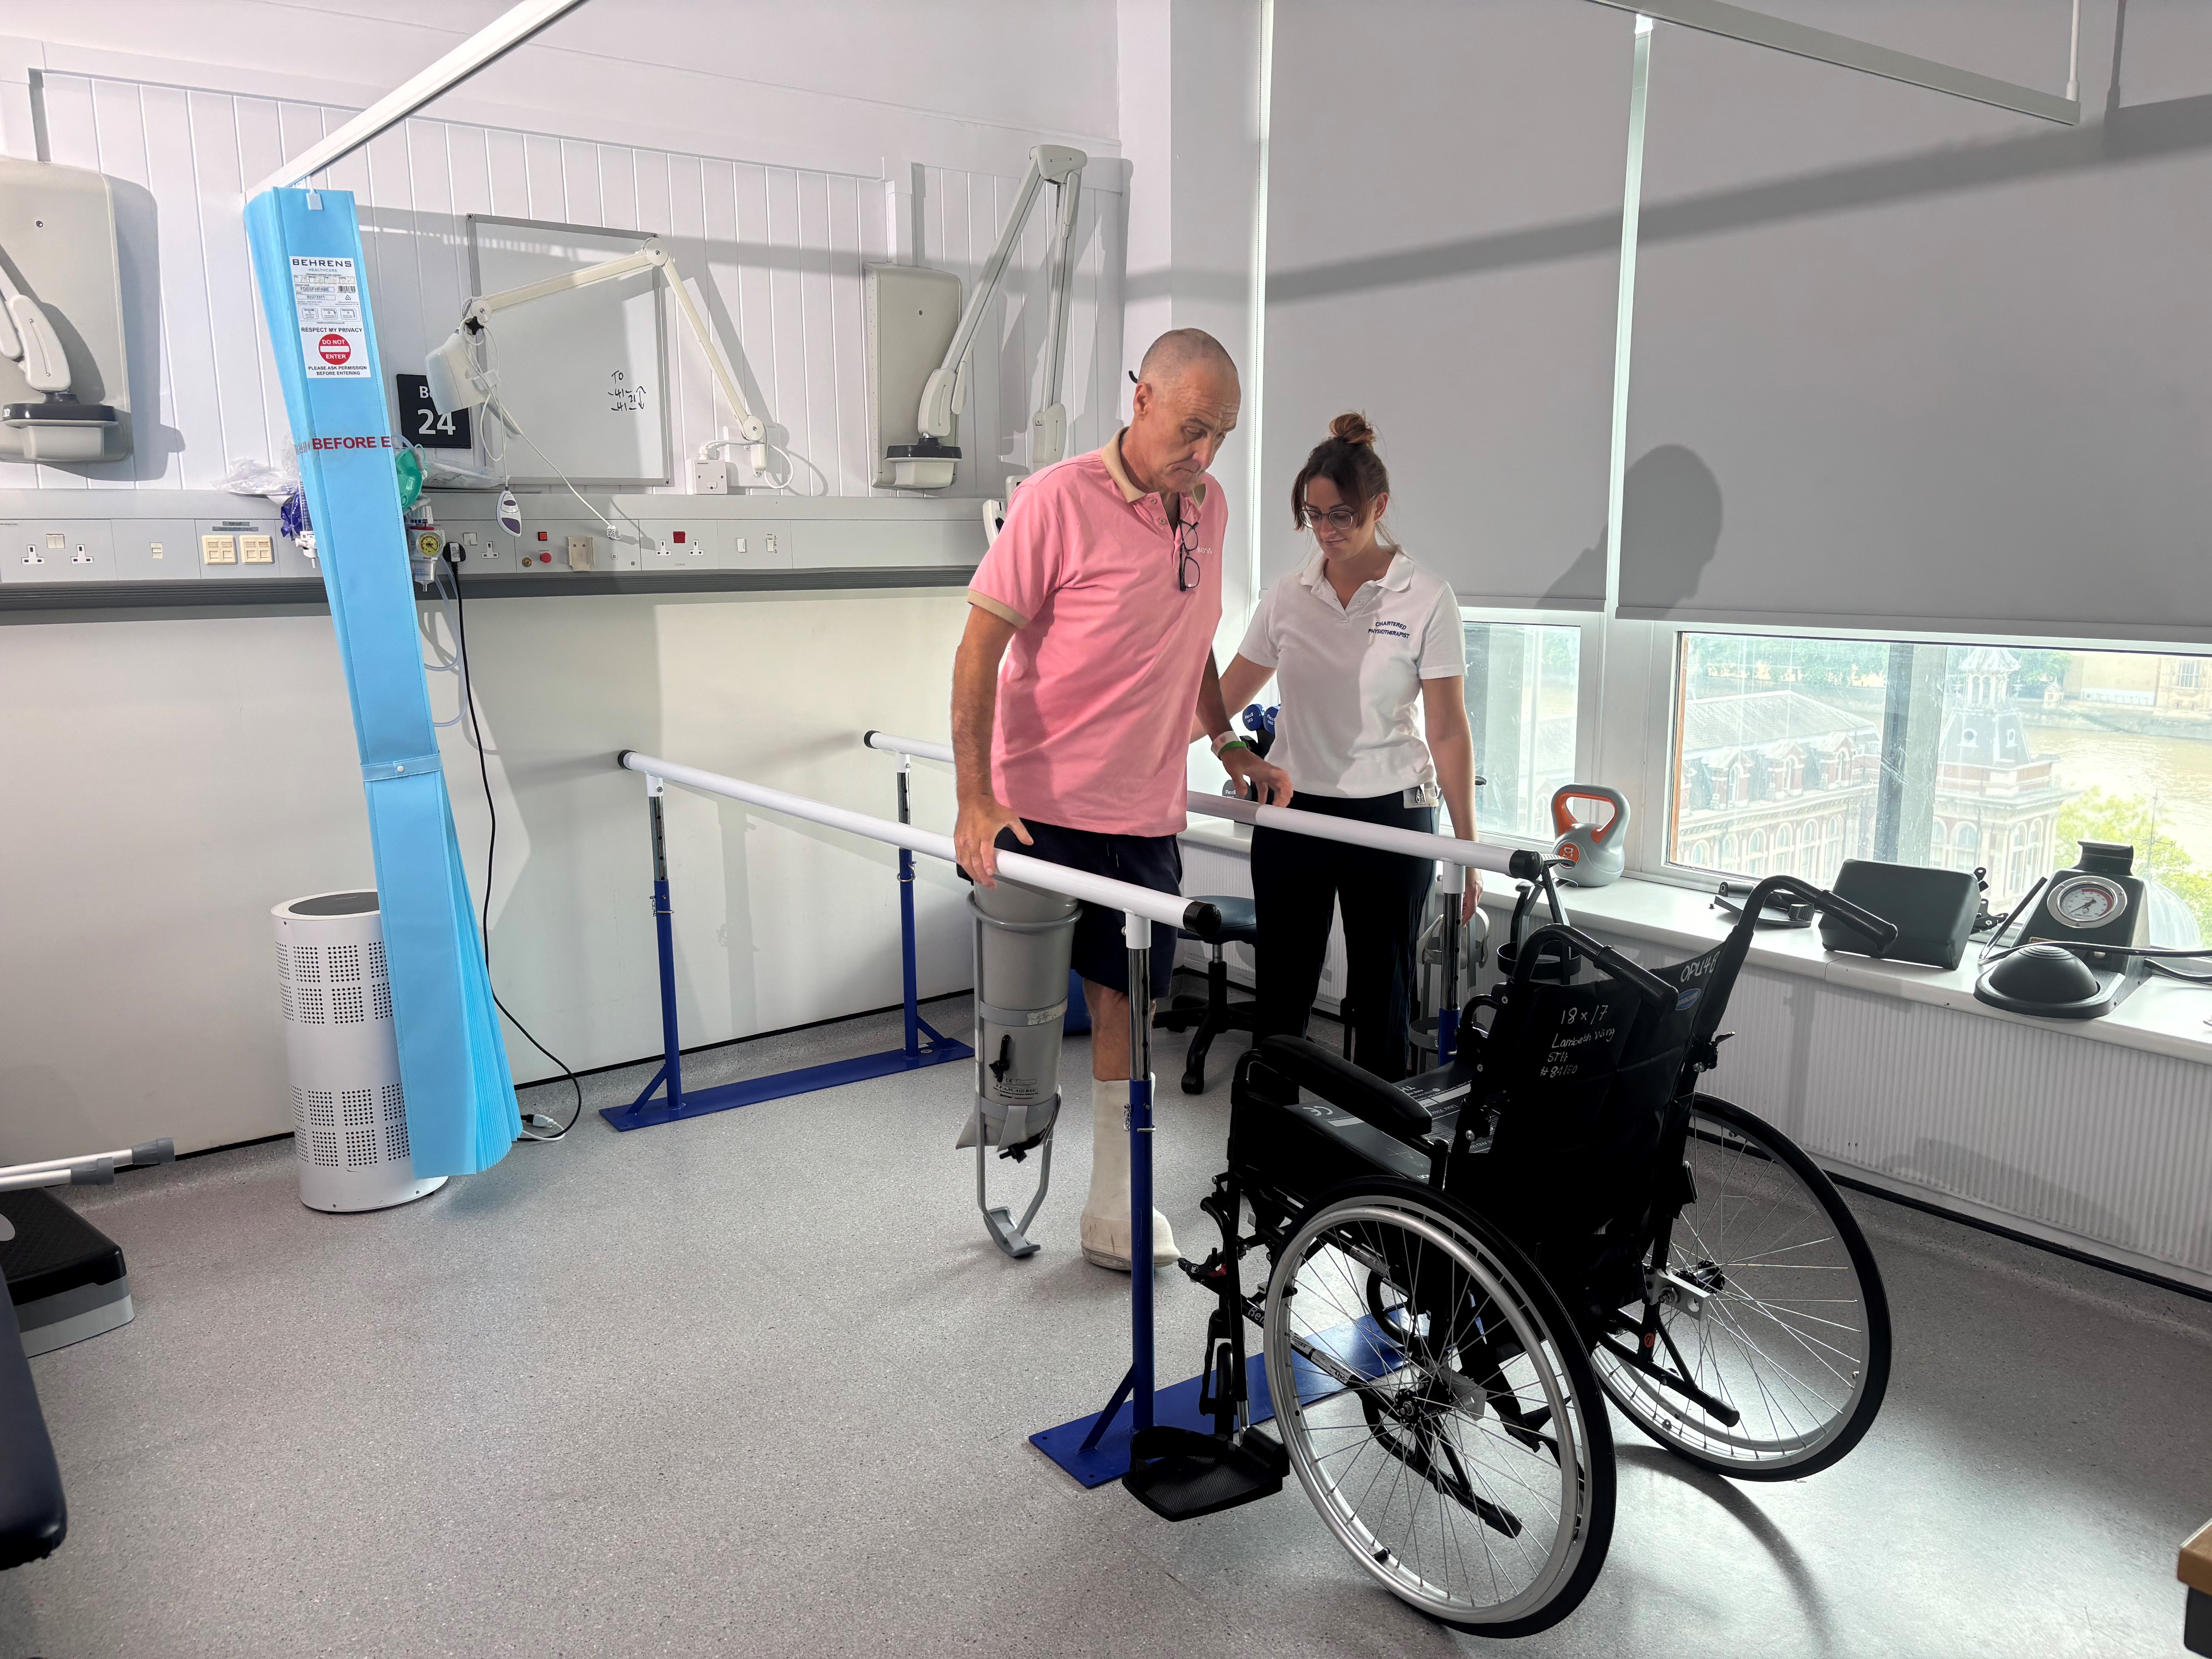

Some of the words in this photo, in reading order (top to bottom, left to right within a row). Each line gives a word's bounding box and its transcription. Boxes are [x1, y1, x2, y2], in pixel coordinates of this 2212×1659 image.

[292, 259, 352, 267] BEHRENS
[611, 370, 623, 384] TO
[417, 409, 456, 435] 24
[312, 436, 377, 450] BEFORE
[1375, 621, 1407, 630] CHARTERED
[1368, 629, 1410, 639] PHYSIOTHERAPIST
[1561, 1007, 1578, 1025] 18
[1590, 1005, 1609, 1025] 17
[1551, 1033, 1592, 1049] Lambeth
[1595, 1028, 1615, 1042] Wing
[1547, 1051, 1568, 1062] STH
